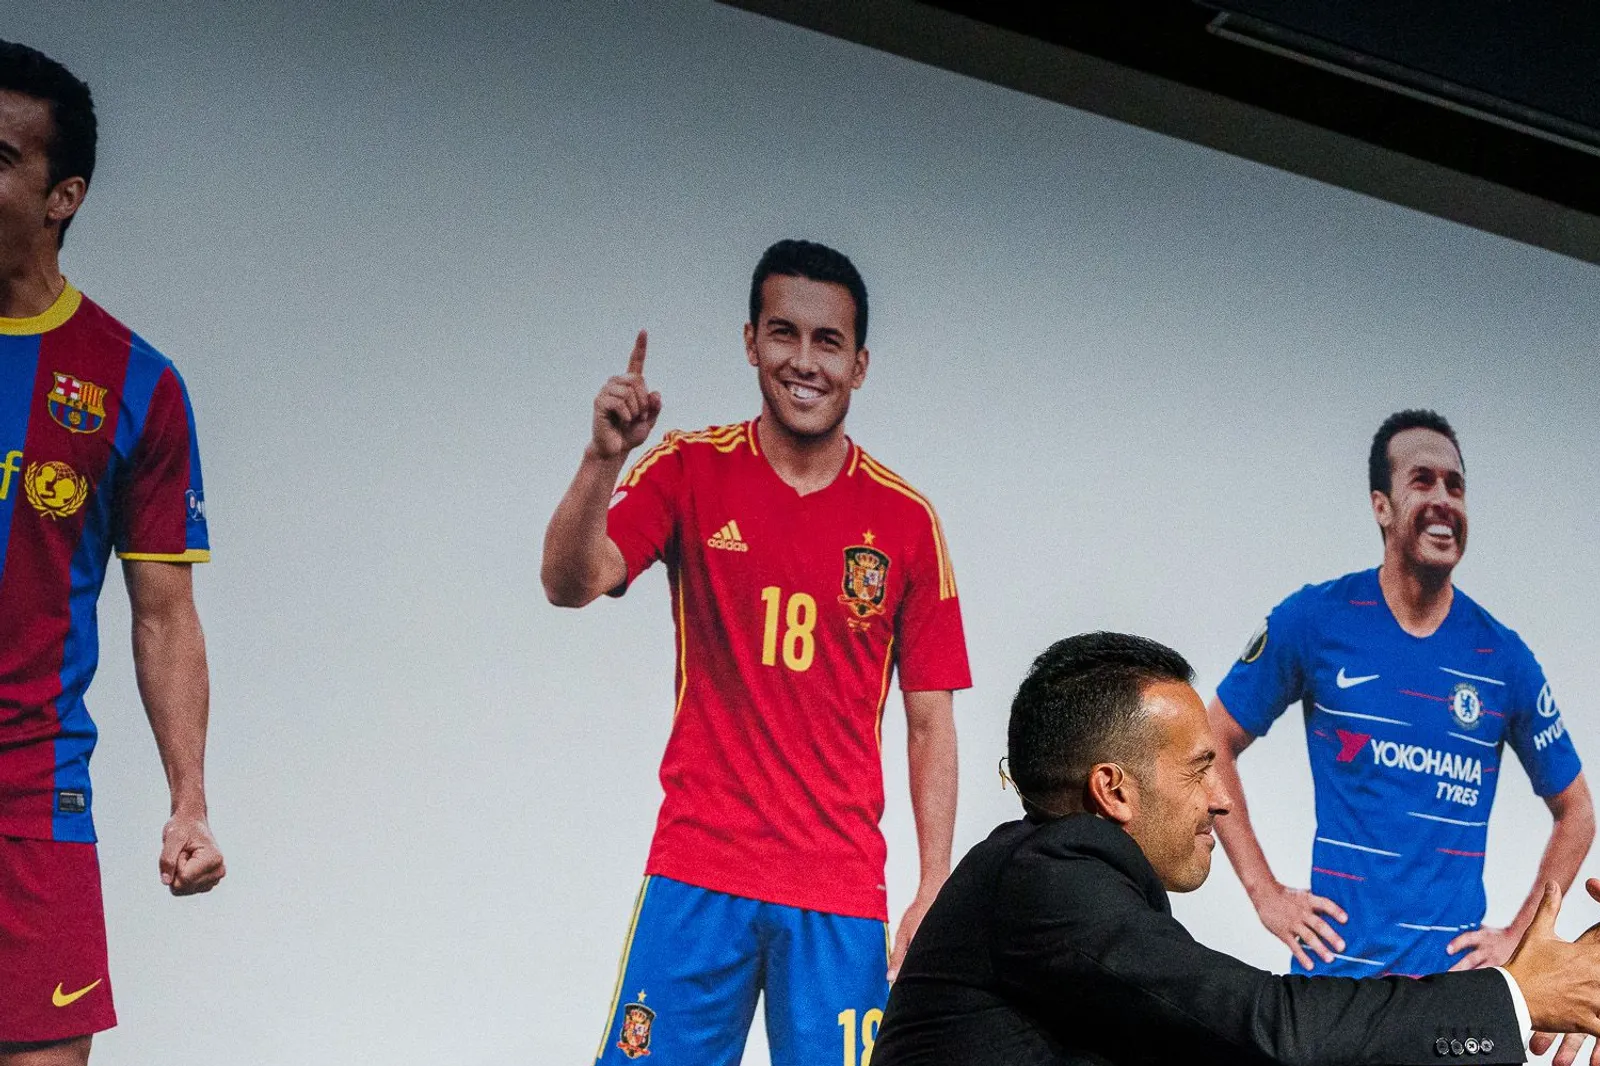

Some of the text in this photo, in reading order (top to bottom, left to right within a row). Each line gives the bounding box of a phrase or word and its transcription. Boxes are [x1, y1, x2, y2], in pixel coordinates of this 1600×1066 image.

[707, 538, 749, 552] adidas
[761, 586, 817, 672] 18
[1371, 739, 1481, 786] YOKOHAMA
[1436, 781, 1479, 807] TYRES
